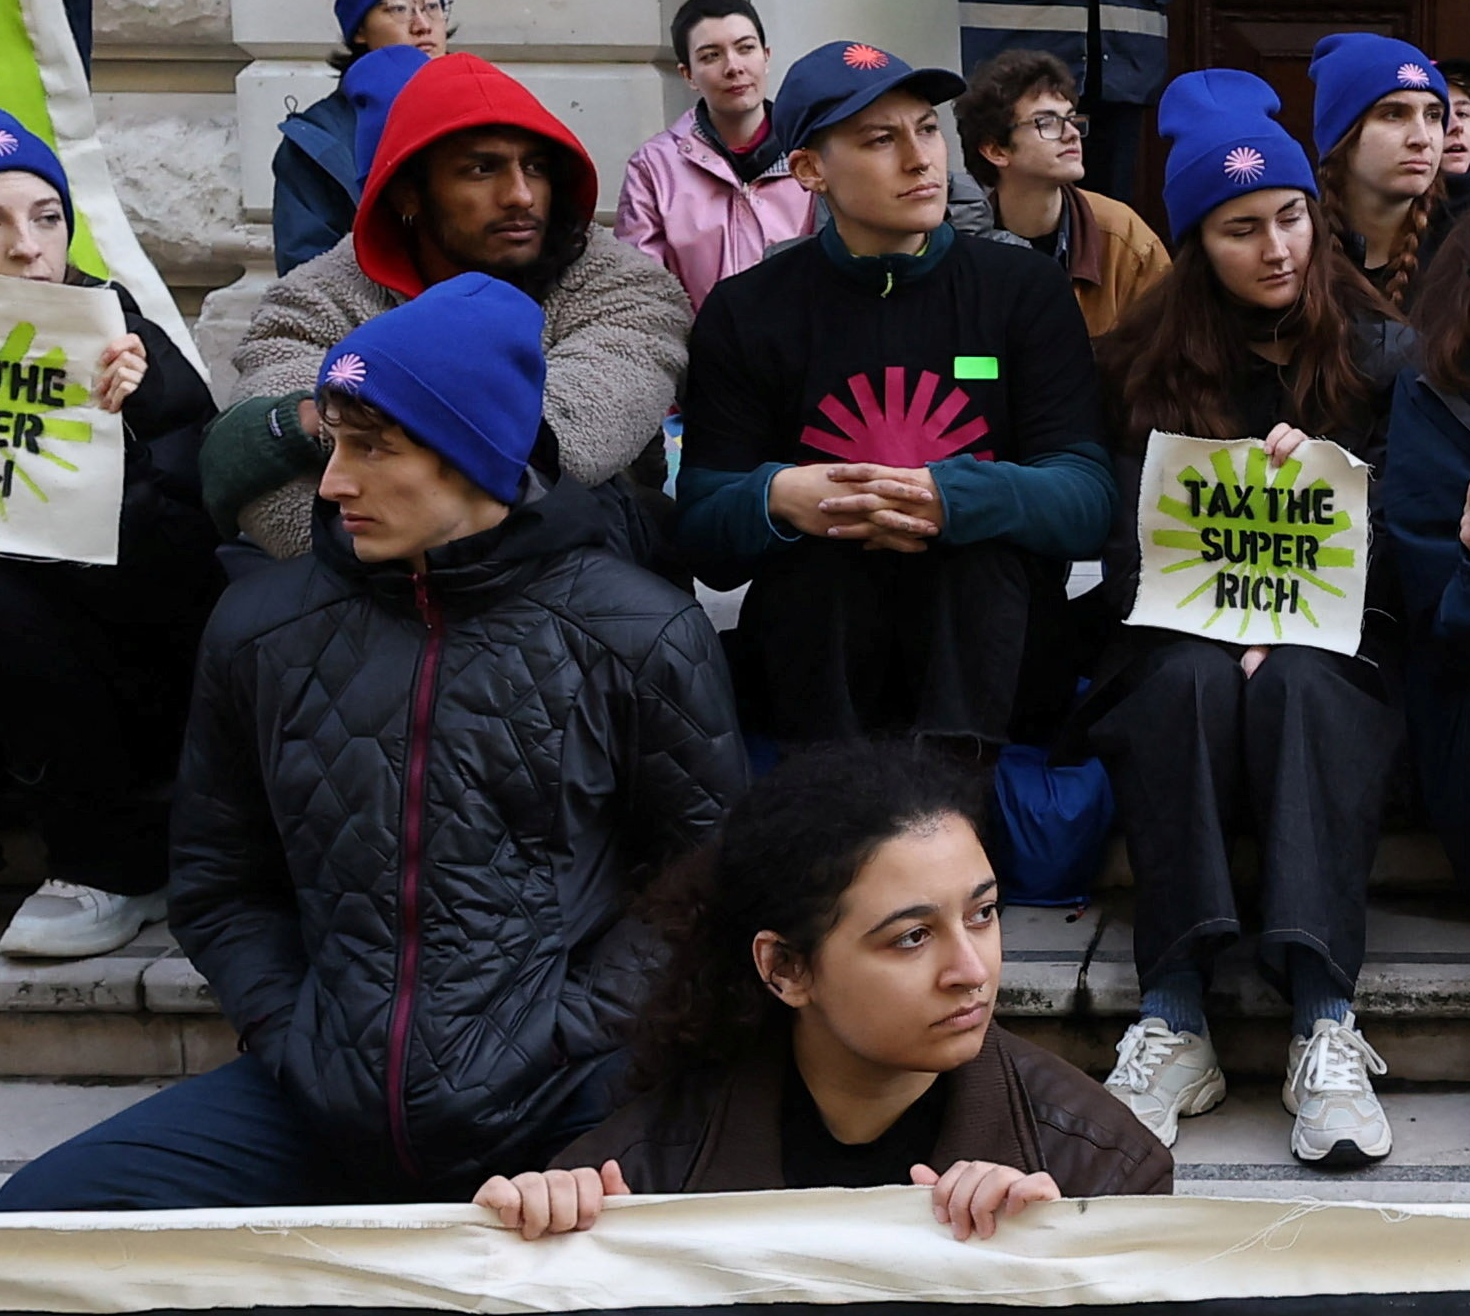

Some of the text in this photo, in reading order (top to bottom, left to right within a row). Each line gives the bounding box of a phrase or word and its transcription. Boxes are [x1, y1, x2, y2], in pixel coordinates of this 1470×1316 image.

[1184, 480, 1334, 525] TAX THE
[1200, 527, 1319, 570] SUPER
[1215, 572, 1299, 614] RICH
